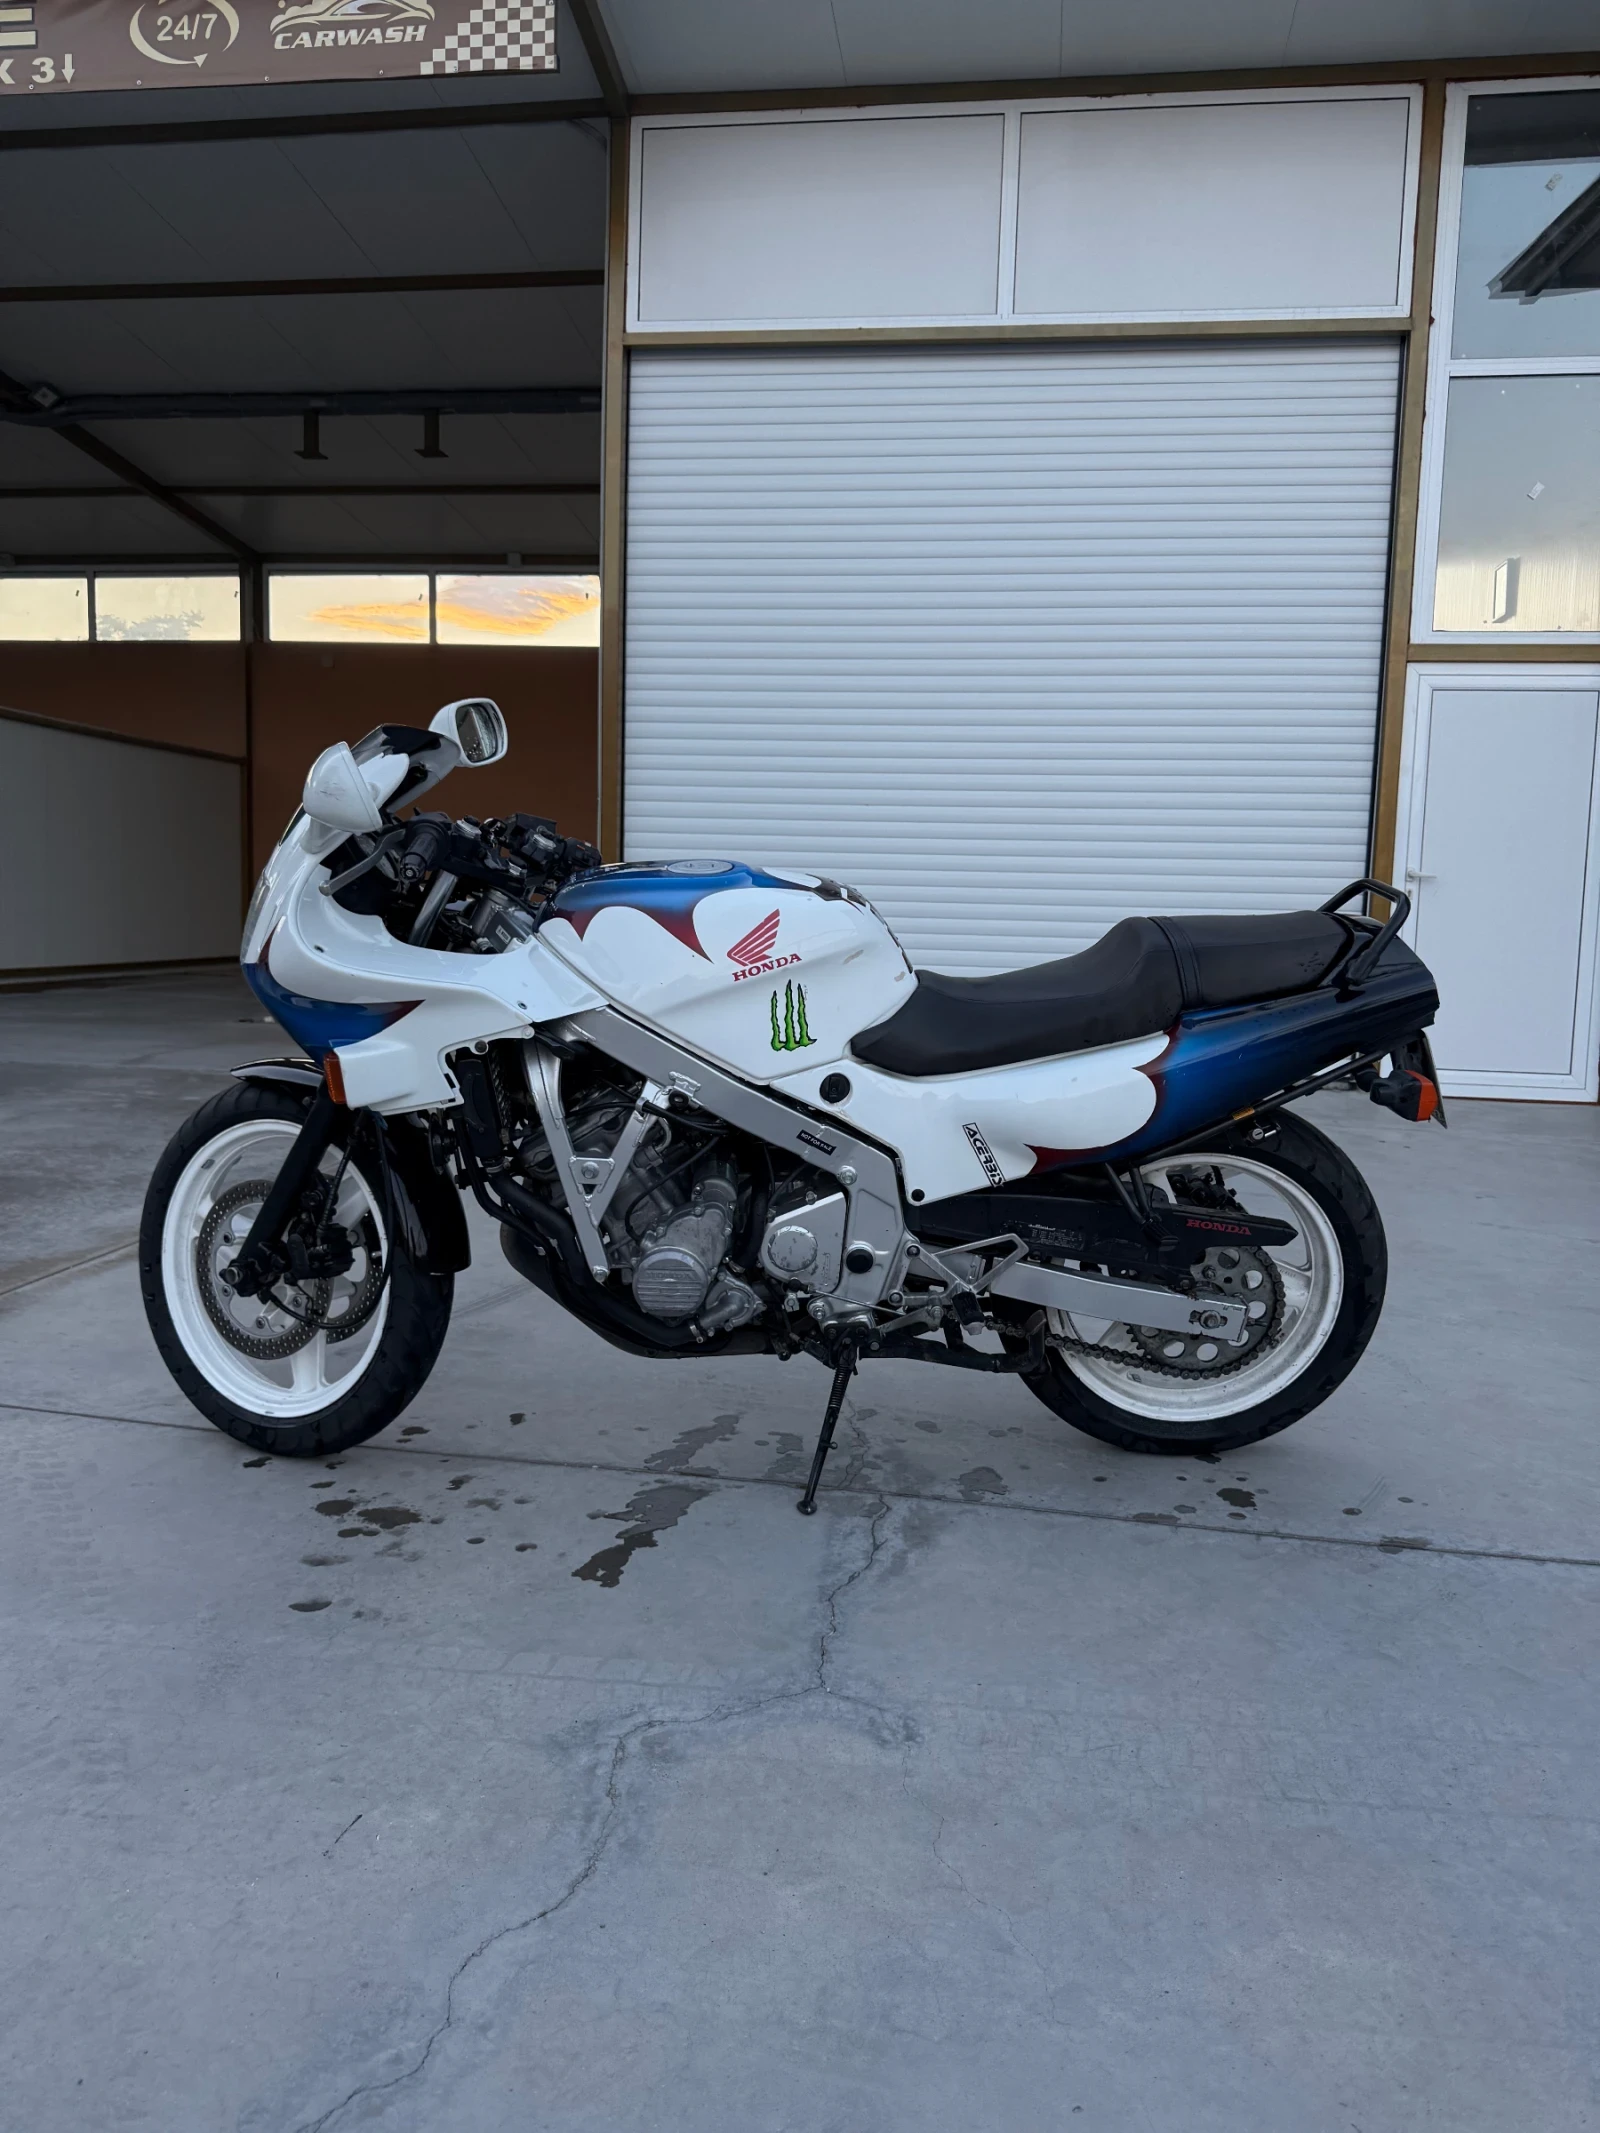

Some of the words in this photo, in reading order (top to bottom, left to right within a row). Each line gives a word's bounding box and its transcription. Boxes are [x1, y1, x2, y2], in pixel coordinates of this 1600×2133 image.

[157, 13, 218, 41] 24/7
[274, 25, 427, 50] CARWASH
[31, 56, 56, 84] 3
[732, 953, 802, 982] HONDA
[800, 1132, 811, 1141] NOT
[810, 1137, 821, 1146] FOR
[1186, 1219, 1252, 1236] HONDA
